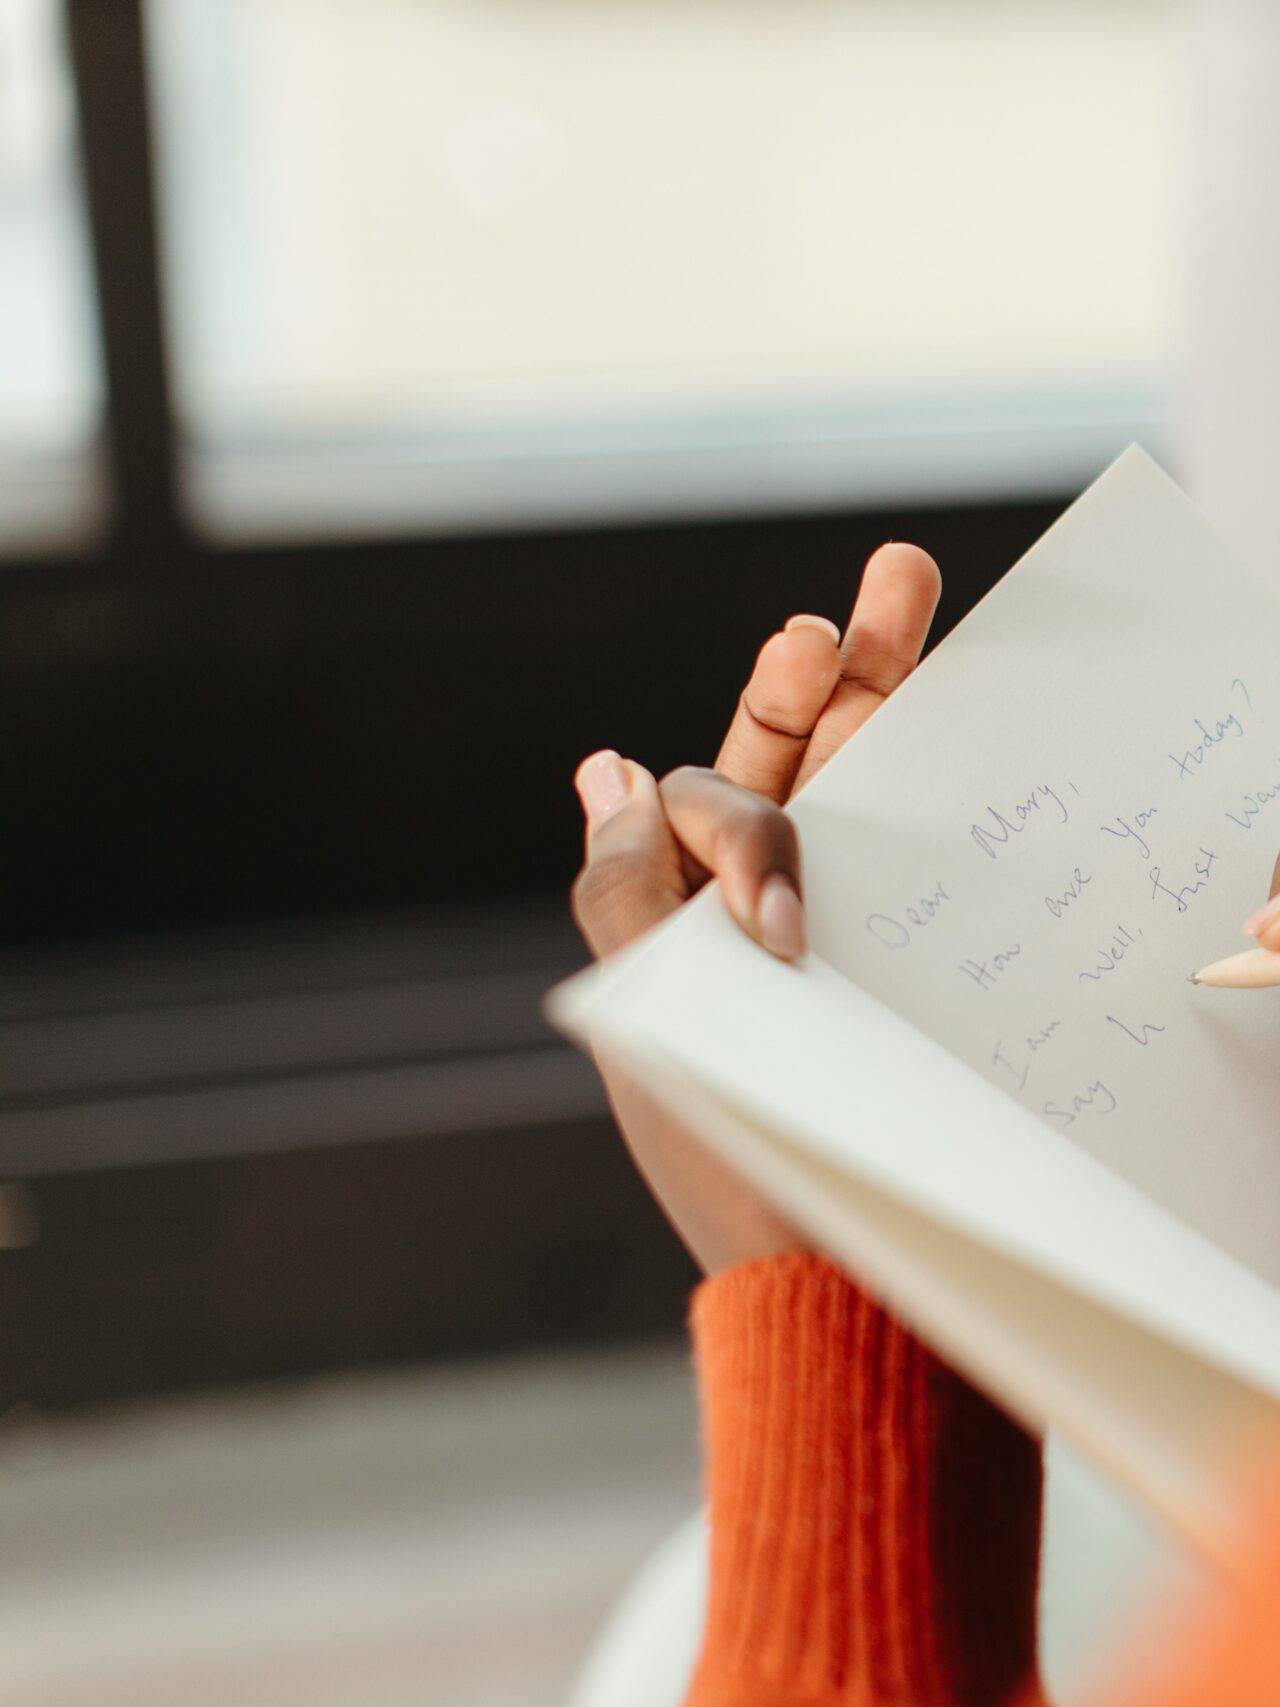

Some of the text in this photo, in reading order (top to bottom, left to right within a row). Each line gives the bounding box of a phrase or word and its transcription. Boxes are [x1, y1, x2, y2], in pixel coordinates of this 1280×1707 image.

[865, 781, 1080, 952] Dear Mary,
[957, 943, 1021, 990] How
[1044, 867, 1092, 918] are
[1167, 677, 1254, 780] today?
[992, 1040, 1030, 1091] I
[1026, 1020, 1062, 1051] am
